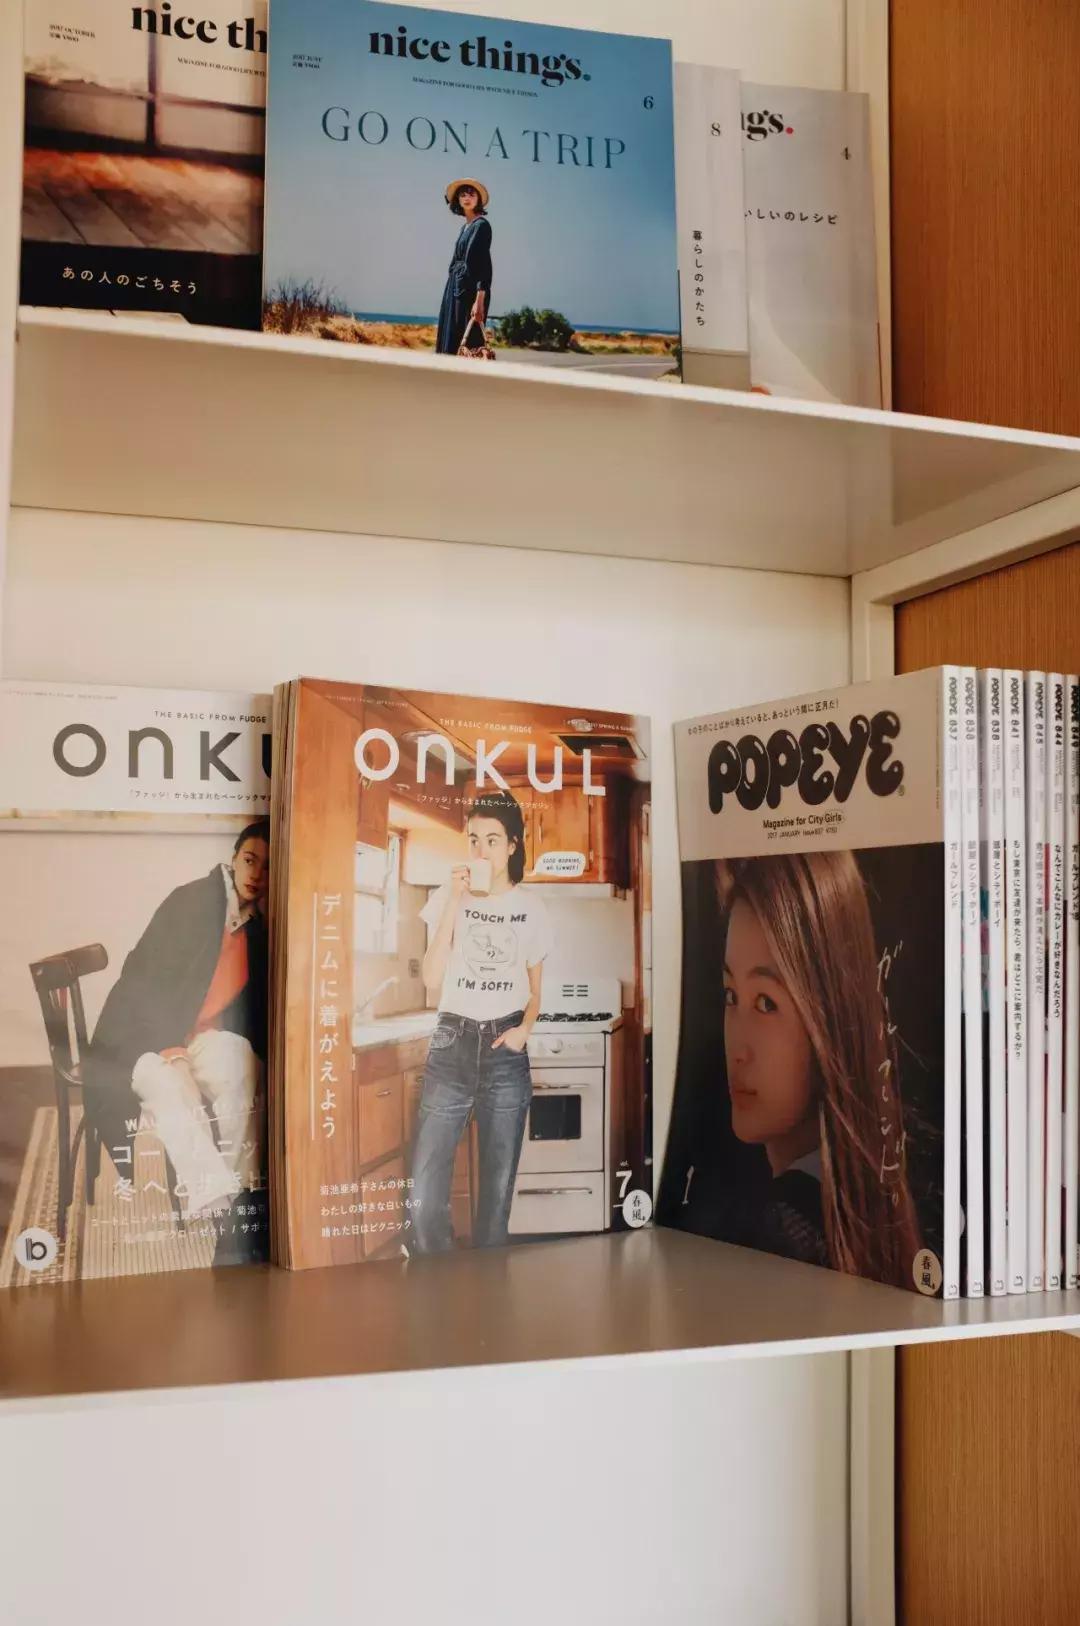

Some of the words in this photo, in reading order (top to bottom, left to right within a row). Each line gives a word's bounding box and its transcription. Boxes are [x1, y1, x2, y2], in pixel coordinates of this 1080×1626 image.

[132, 2, 217, 44] nice
[369, 26, 450, 63] nice
[643, 95, 654, 110] 6
[321, 106, 389, 145] GO
[406, 116, 469, 155] ON
[485, 127, 510, 160] A
[521, 130, 626, 169] TRIP
[710, 122, 721, 137] 8
[841, 147, 852, 160] 4
[63, 266, 197, 294] あの人のごちそう
[692, 230, 705, 327] 暮らしのかたち
[991, 678, 1000, 717] POPEYE
[1010, 677, 1019, 717] POPEYE
[1055, 684, 1063, 722] POPEYE
[154, 710, 172, 719] THE
[176, 712, 205, 720] BASIC
[209, 714, 236, 722] FROM
[239, 715, 267, 723] FUDGE
[1011, 719, 1020, 739] 841
[1055, 725, 1063, 746] 844
[708, 710, 904, 814] POPEYE
[763, 819, 794, 830] Magazine
[796, 816, 806, 825] for
[808, 815, 823, 825] City
[825, 813, 842, 822] Girls
[465, 909, 504, 923] TOUCH
[510, 914, 527, 922] ME
[457, 977, 476, 990] I'M
[481, 981, 513, 991] SOFT!
[320, 893, 342, 1139] デニムに着がえよう
[616, 1170, 632, 1198] 7
[321, 1199, 422, 1217] わたしの好きな白いもの
[321, 1220, 411, 1237] 晴れた日はピクニック
